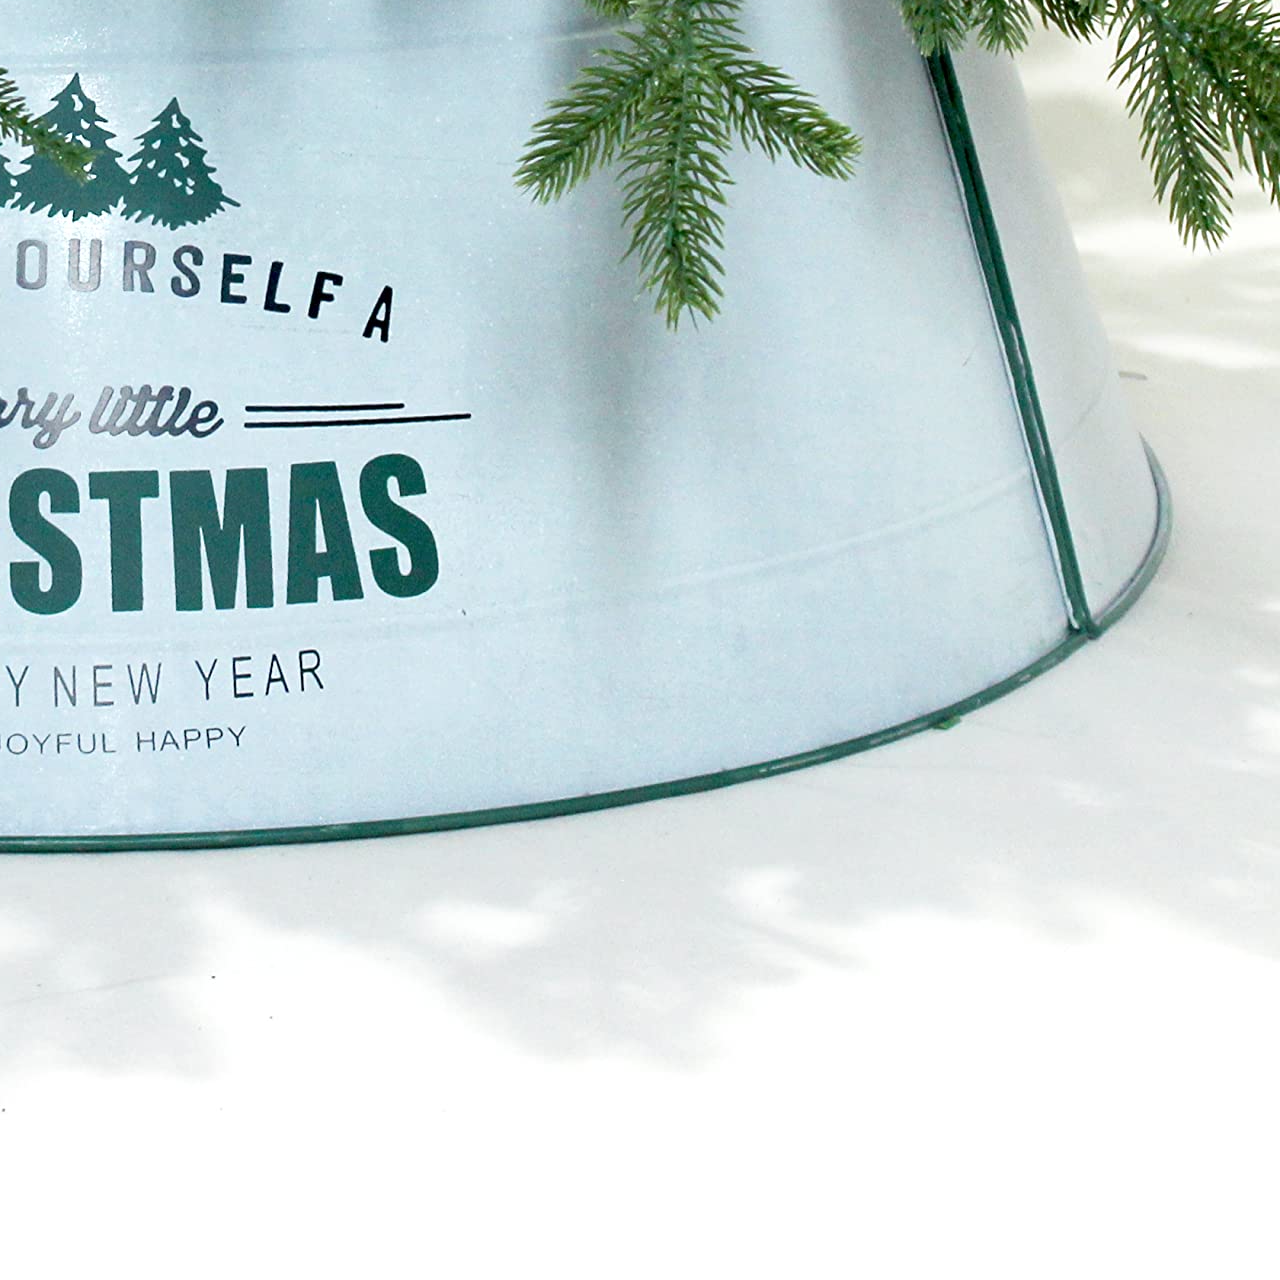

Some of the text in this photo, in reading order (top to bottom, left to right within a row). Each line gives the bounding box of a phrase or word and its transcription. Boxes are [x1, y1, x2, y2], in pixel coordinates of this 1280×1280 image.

[361, 284, 394, 344] A
[88, 383, 225, 439] little
[53, 662, 163, 708] NEW
[194, 648, 325, 702] YEAR
[136, 725, 247, 753] HAPPY
